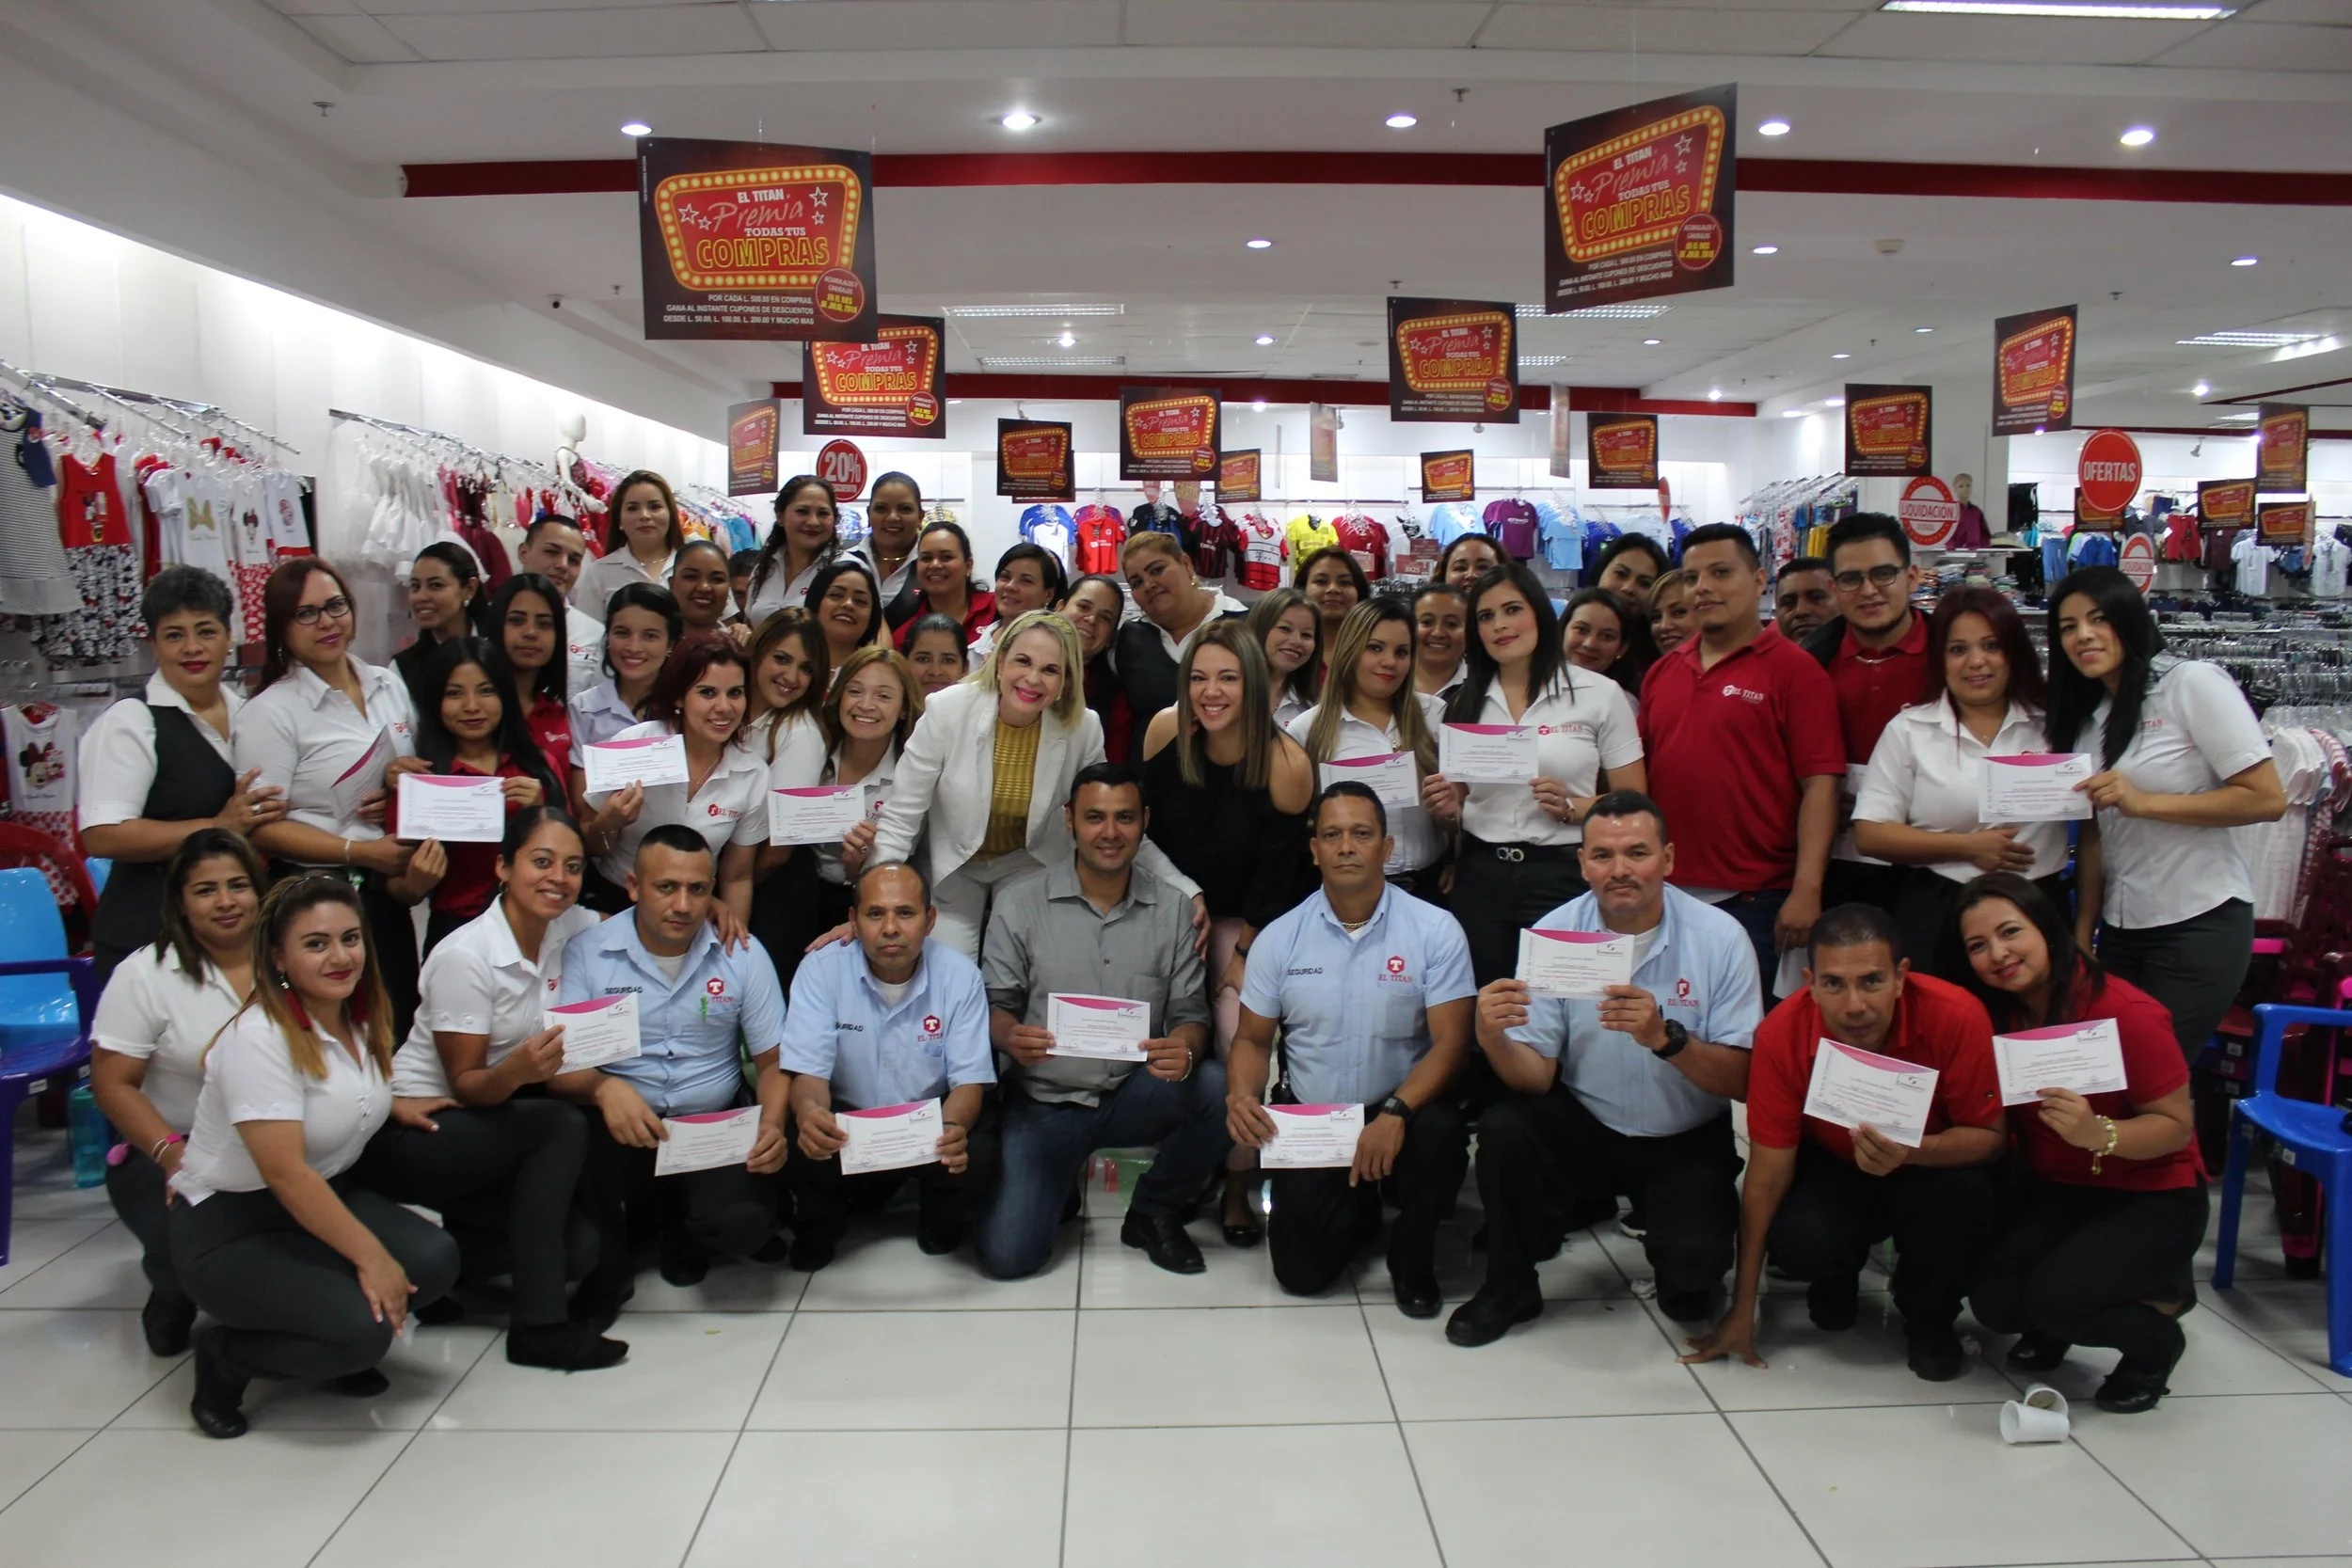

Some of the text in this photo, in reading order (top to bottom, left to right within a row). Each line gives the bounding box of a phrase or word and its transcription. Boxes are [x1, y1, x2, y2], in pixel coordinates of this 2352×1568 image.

[1613, 146, 1653, 170] EL TITAN
[738, 189, 785, 203] EL TITAN
[1618, 180, 1670, 201] TODAS TUS
[707, 200, 804, 232] Premia
[1581, 184, 1691, 240] COMPRAS
[744, 227, 806, 237] TODAS TUS
[696, 237, 830, 268] COMPRAS
[870, 341, 890, 350] TITAN
[1420, 357, 1492, 378] COMPRAS
[835, 372, 917, 391] COMPRAS
[824, 451, 861, 483] 20%
[2084, 461, 2137, 483] OFERTAS
[1741, 689, 1765, 701] TITAN
[1287, 967, 1324, 975] SEGURIDAD
[605, 986, 643, 994] SEGURIDAD
